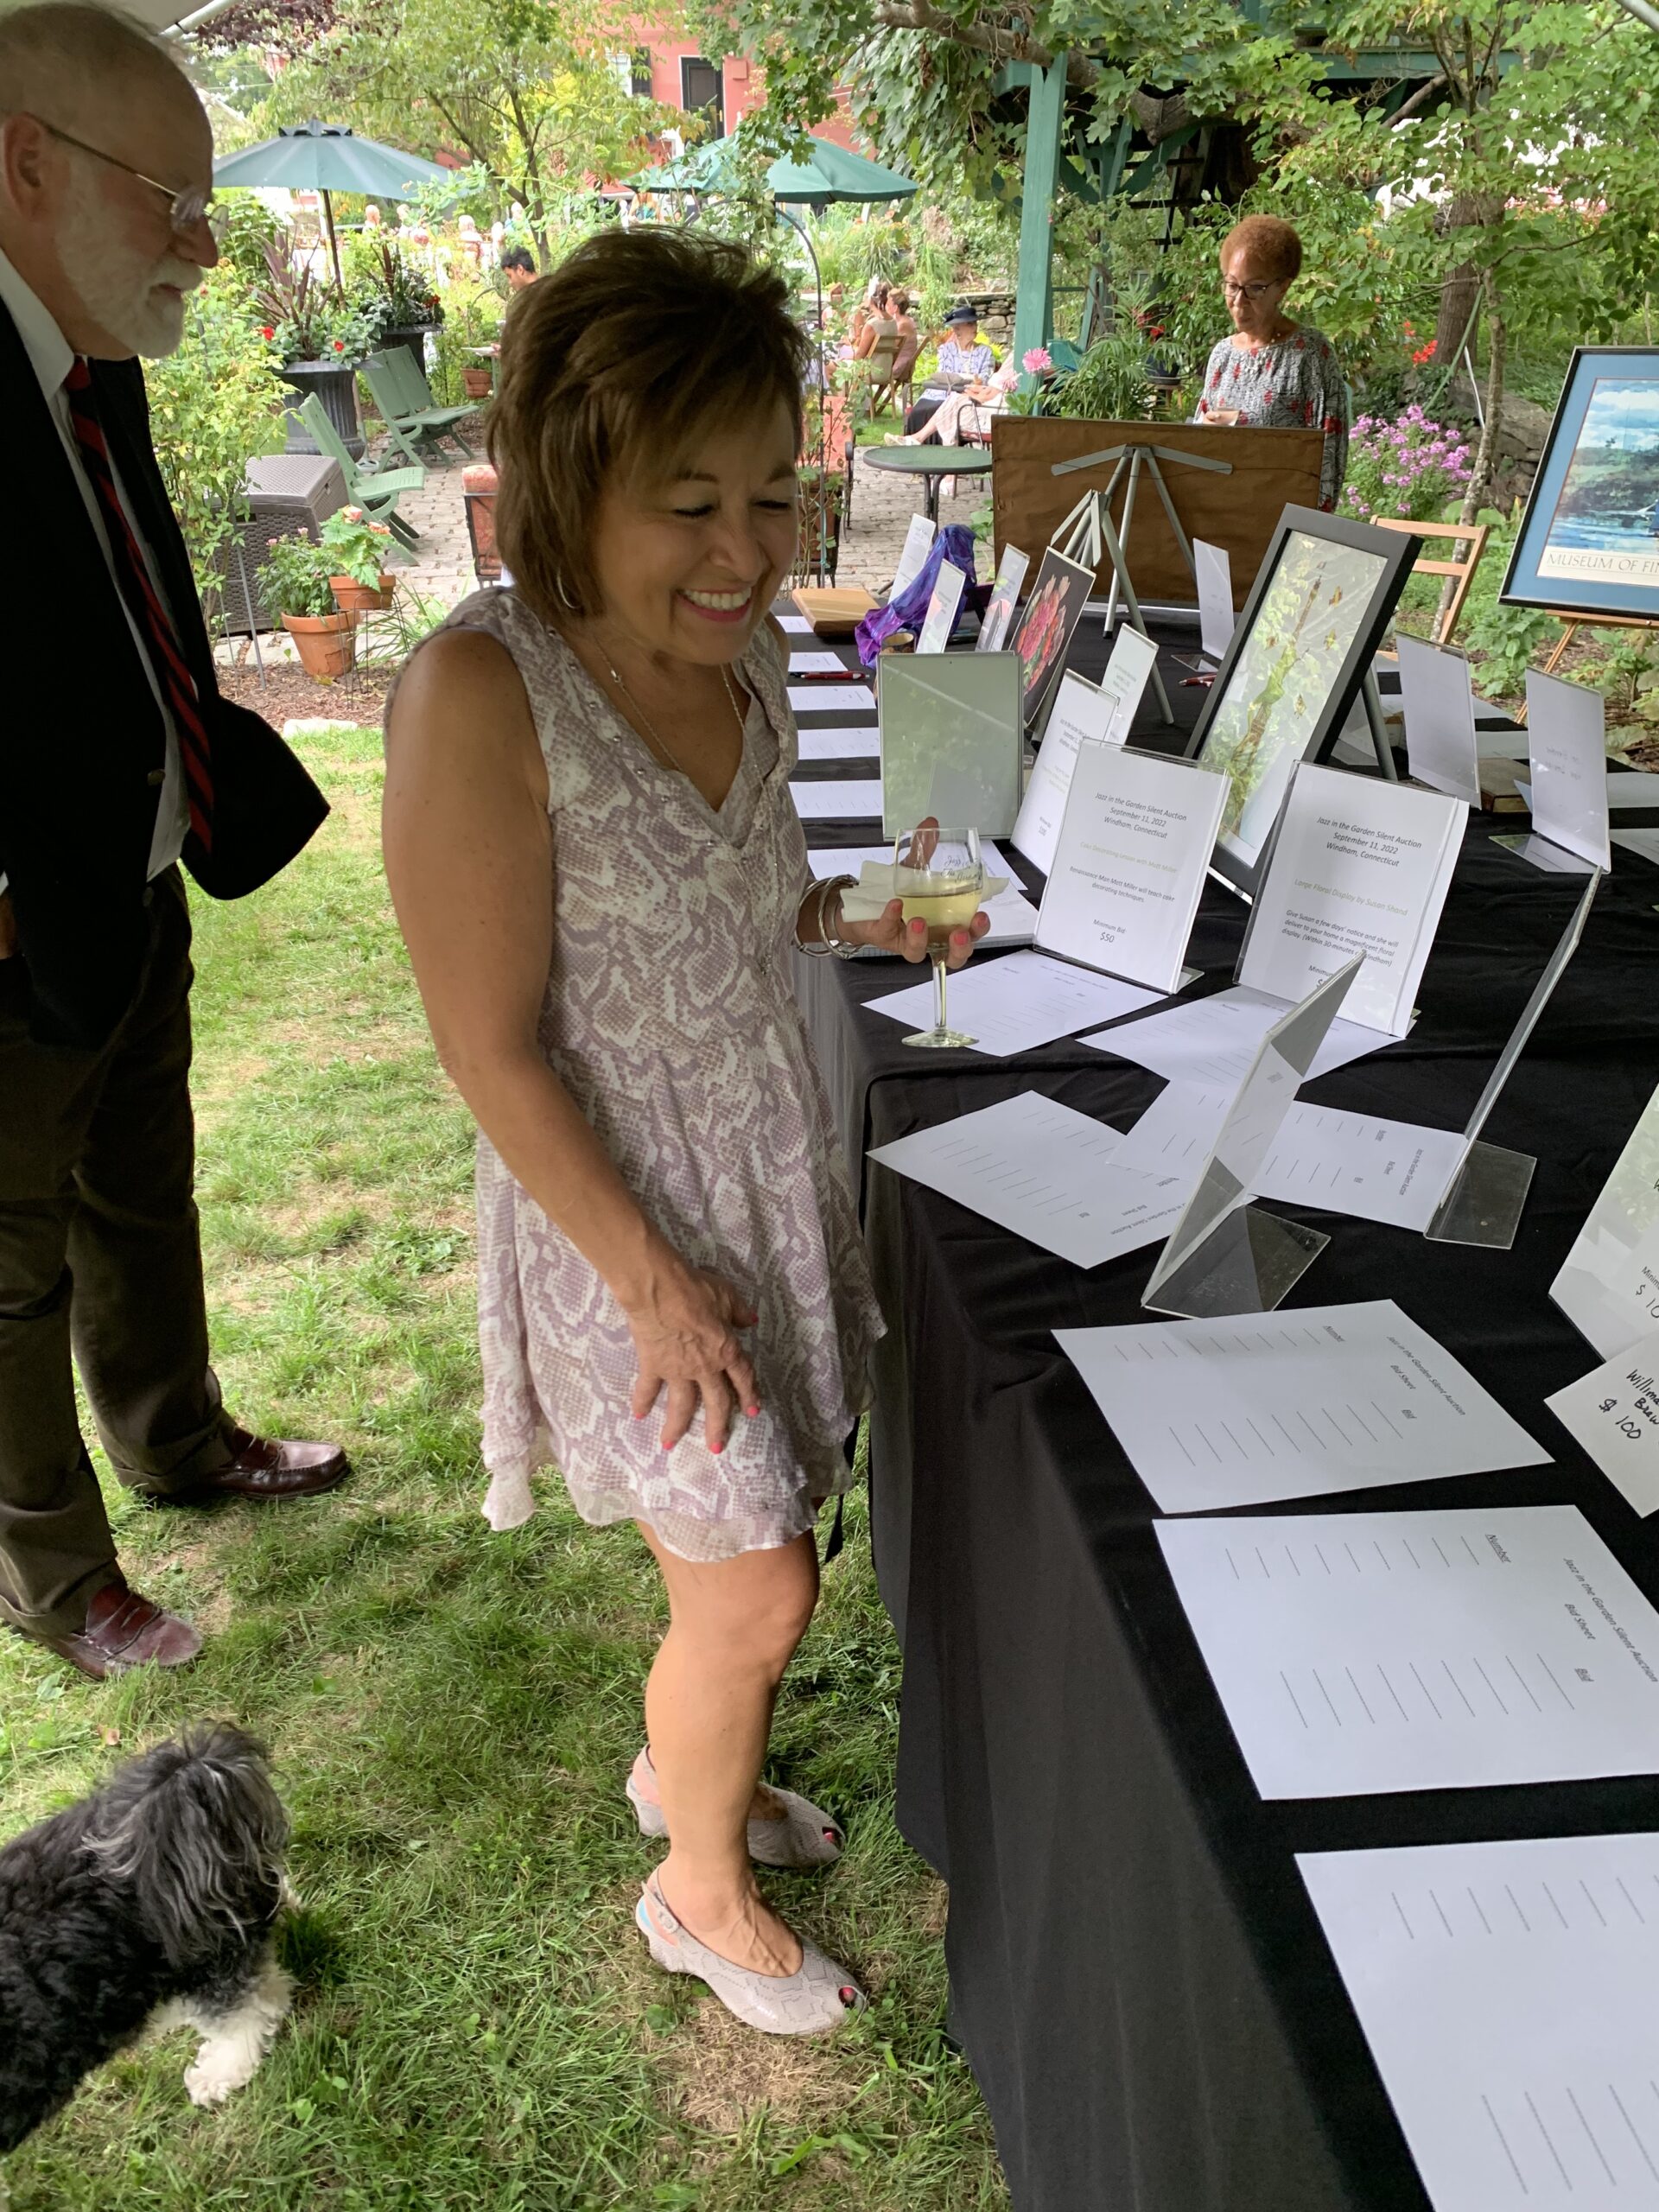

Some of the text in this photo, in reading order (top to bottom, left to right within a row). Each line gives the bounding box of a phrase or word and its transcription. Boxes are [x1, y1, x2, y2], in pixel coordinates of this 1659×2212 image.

[1547, 552, 1613, 569] MUSEUM
[1618, 558, 1639, 571] OF
[1095, 792, 1108, 802] Jazz
[1115, 797, 1124, 805] the
[1125, 800, 1147, 810] Garden
[1147, 805, 1163, 816] Silent
[1164, 810, 1187, 822] Auction
[1109, 807, 1141, 821] September
[1152, 817, 1166, 827] 2022
[1134, 824, 1167, 839] Connecticut
[1317, 817, 1331, 826] Jazz
[1351, 824, 1375, 837] Garden
[1376, 830, 1395, 842] Silent
[1395, 836, 1421, 849] Auction
[1333, 832, 1398, 855] September 11, 2022
[1326, 842, 1400, 867] Windham, Connecticut
[1070, 866, 1098, 880] Renaissance
[1098, 874, 1110, 883] Man
[1110, 877, 1123, 887] Matt
[1123, 881, 1138, 891] Miller
[1147, 890, 1162, 899] teach
[1162, 893, 1175, 902] cake
[1091, 882, 1117, 896] decorating
[1294, 879, 1408, 916] Large Floral Display by Susan Shand
[1093, 918, 1116, 932] Minimum
[1100, 931, 1115, 943] $50
[1286, 909, 1299, 918] Give
[1299, 913, 1315, 923] Susan
[1319, 919, 1331, 929] few
[1347, 928, 1364, 938] notice
[1376, 937, 1387, 945] she
[1388, 939, 1399, 948] will
[1284, 919, 1303, 929] deliver
[1309, 927, 1324, 936] your
[1323, 931, 1339, 941] home
[1344, 938, 1378, 952] magnificent
[1378, 948, 1395, 957] floral
[1302, 934, 1323, 945] (Within
[1636, 1284, 1646, 1296] $
[1322, 1325, 1346, 1343] Number
[1390, 1365, 1416, 1389] Bid Sheet
[1412, 1359, 1432, 1378] Garden
[1428, 1379, 1446, 1394] Silent
[1443, 1395, 1465, 1414] Auction
[1401, 1409, 1417, 1419] Bid
[1599, 1398, 1642, 1439] $ 100
[1485, 1534, 1511, 1563] Number
[1563, 1558, 1580, 1573] Jazz
[1581, 1583, 1595, 1596] the
[1592, 1597, 1617, 1625] Garden
[1613, 1627, 1635, 1649] Silent
[1630, 1649, 1658, 1682] Auction
[1565, 1604, 1596, 1640] Bid Sheet
[1574, 1668, 1595, 1682] Bid
